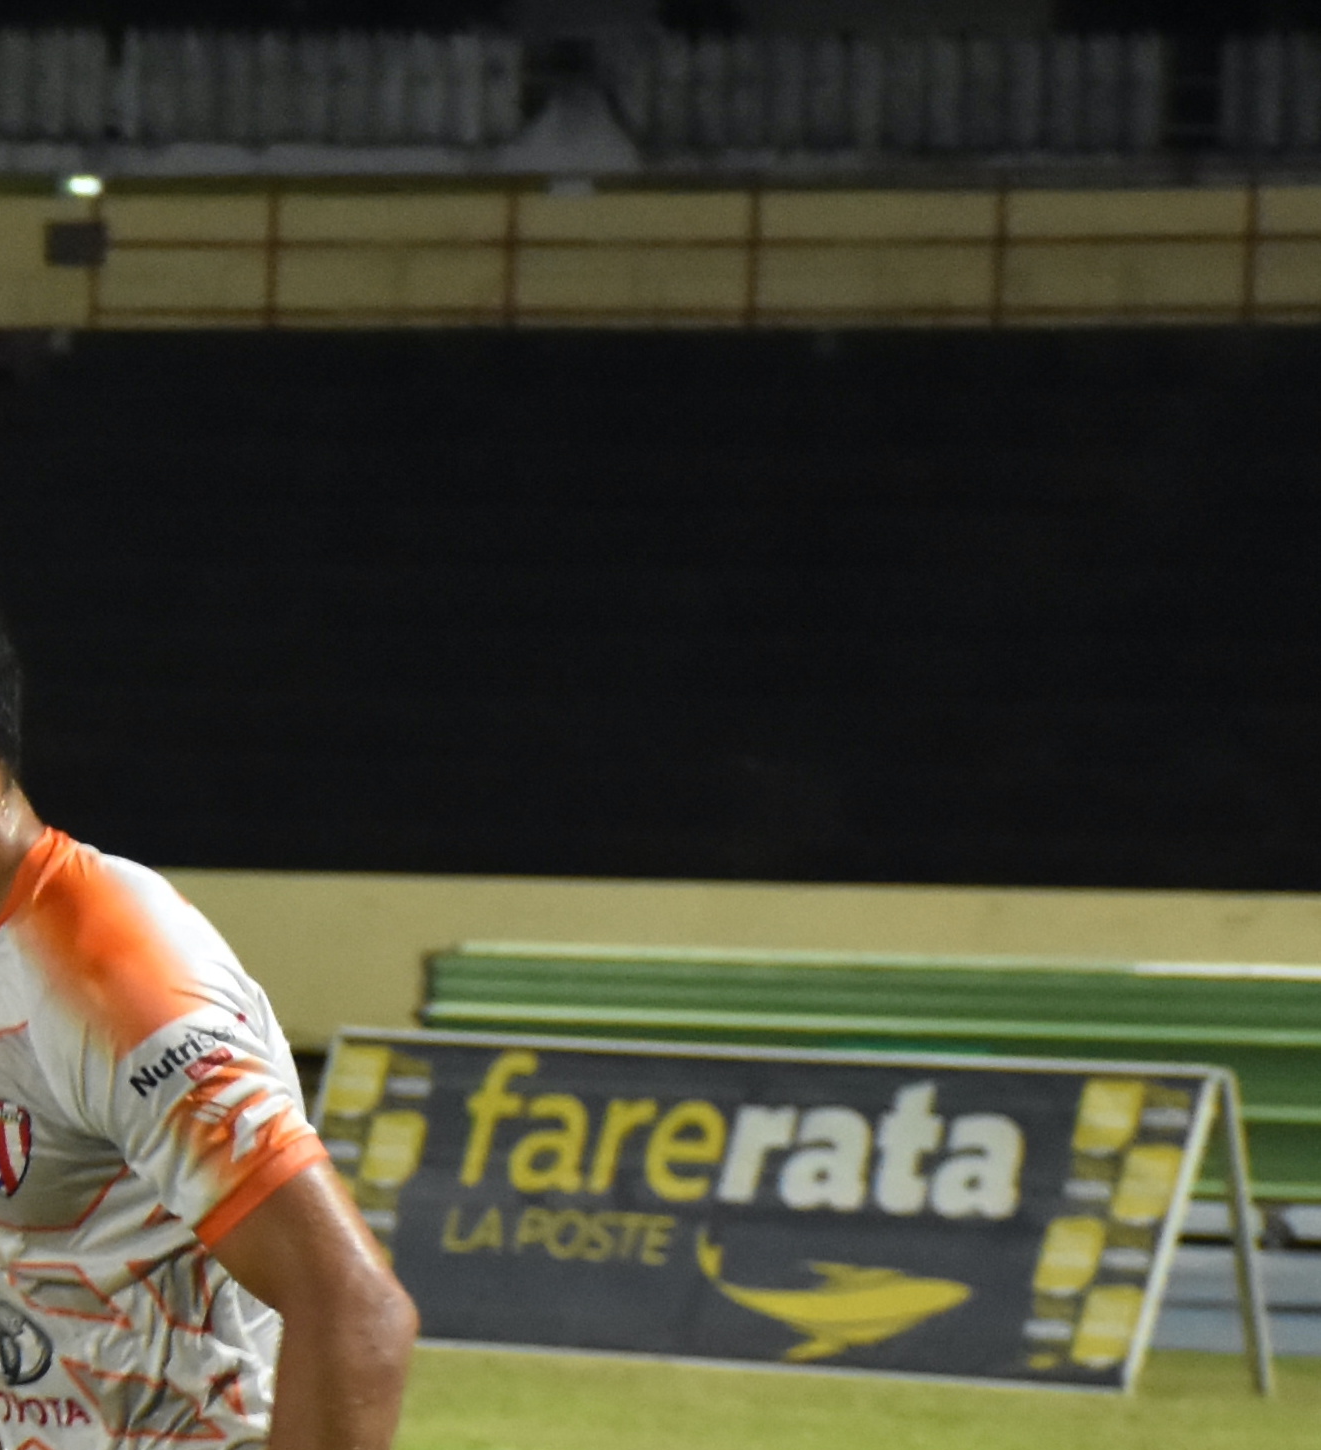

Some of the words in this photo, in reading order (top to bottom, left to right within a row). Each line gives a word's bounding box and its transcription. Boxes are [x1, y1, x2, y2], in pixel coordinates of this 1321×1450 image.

[459, 1051, 1025, 1220] farerata
[442, 1207, 501, 1255] LA
[513, 1213, 677, 1267] POSTE
